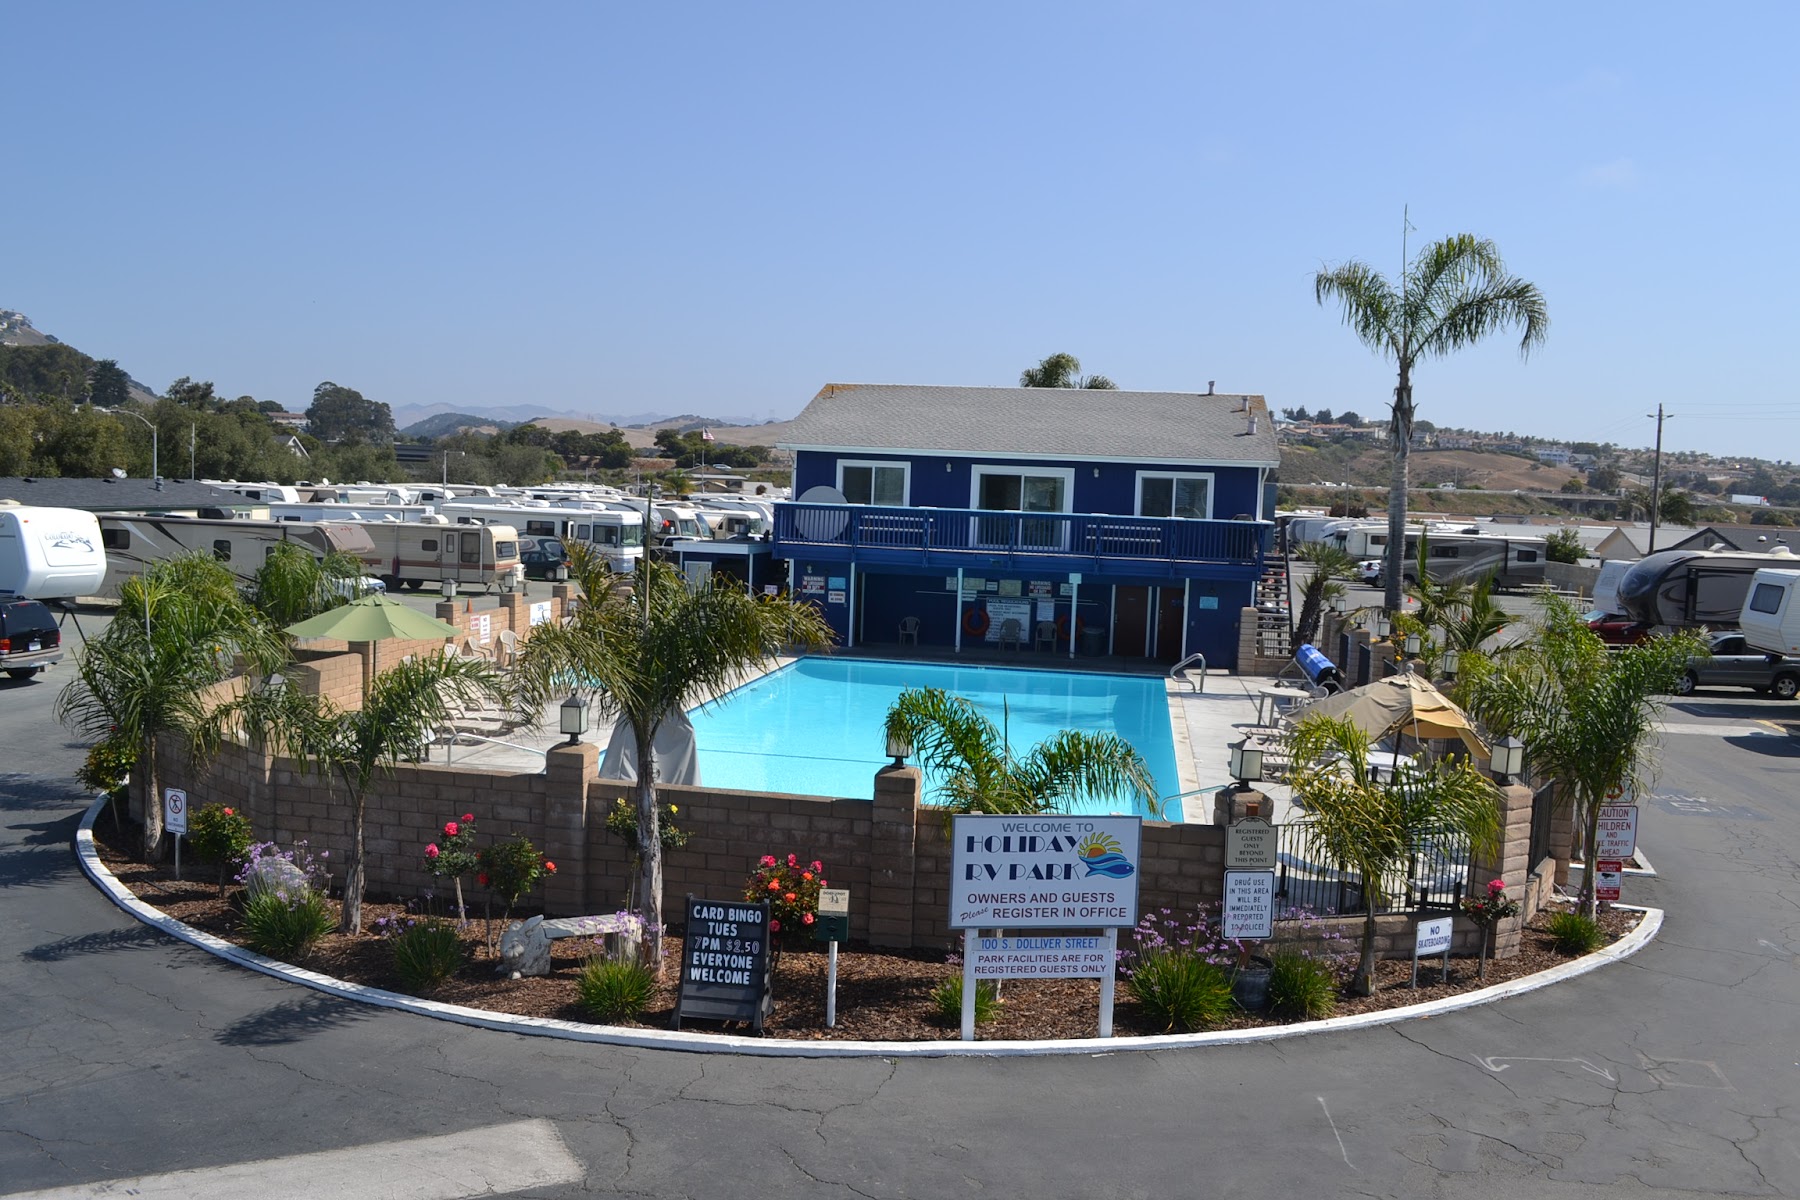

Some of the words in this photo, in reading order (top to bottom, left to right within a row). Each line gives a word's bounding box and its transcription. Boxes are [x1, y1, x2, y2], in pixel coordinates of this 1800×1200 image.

[1598, 809, 1629, 818] CAUTION
[1001, 823, 1071, 833] WELCOME
[1076, 823, 1094, 833] TO
[1597, 822, 1632, 830] HILDREN
[966, 835, 1082, 853] HOLIDAY
[965, 863, 1002, 881] RV
[1009, 863, 1080, 881] PARK
[967, 893, 1026, 904] OWNERS
[1030, 893, 1057, 903] AND
[1061, 892, 1115, 903] GUESTS
[693, 906, 724, 921] CARD
[728, 908, 762, 924] BINGO
[959, 906, 990, 922] Please
[992, 907, 1059, 919] REGISTER
[1063, 907, 1076, 918] IN
[1080, 907, 1127, 918] OFFICE
[708, 922, 738, 937] TUES
[1430, 926, 1440, 935] NO
[694, 936, 721, 951] 7PM
[726, 940, 760, 955] $2.50
[981, 939, 997, 950] 100
[1002, 939, 1011, 949] S.
[1016, 938, 1061, 950] DOLLIVER
[1065, 938, 1099, 949] STREET
[1418, 936, 1450, 948] SKATEBOARDING
[692, 952, 753, 969] EVERYONE
[978, 955, 1004, 963] PARK
[1007, 955, 1059, 963] FACILITIES
[1061, 954, 1081, 962] ARE
[1084, 954, 1104, 962] FOR
[974, 966, 1037, 974] REGISTERED
[1039, 965, 1078, 973] GUESTS
[1081, 965, 1107, 973] ONLY
[690, 967, 751, 985] WELCOME
